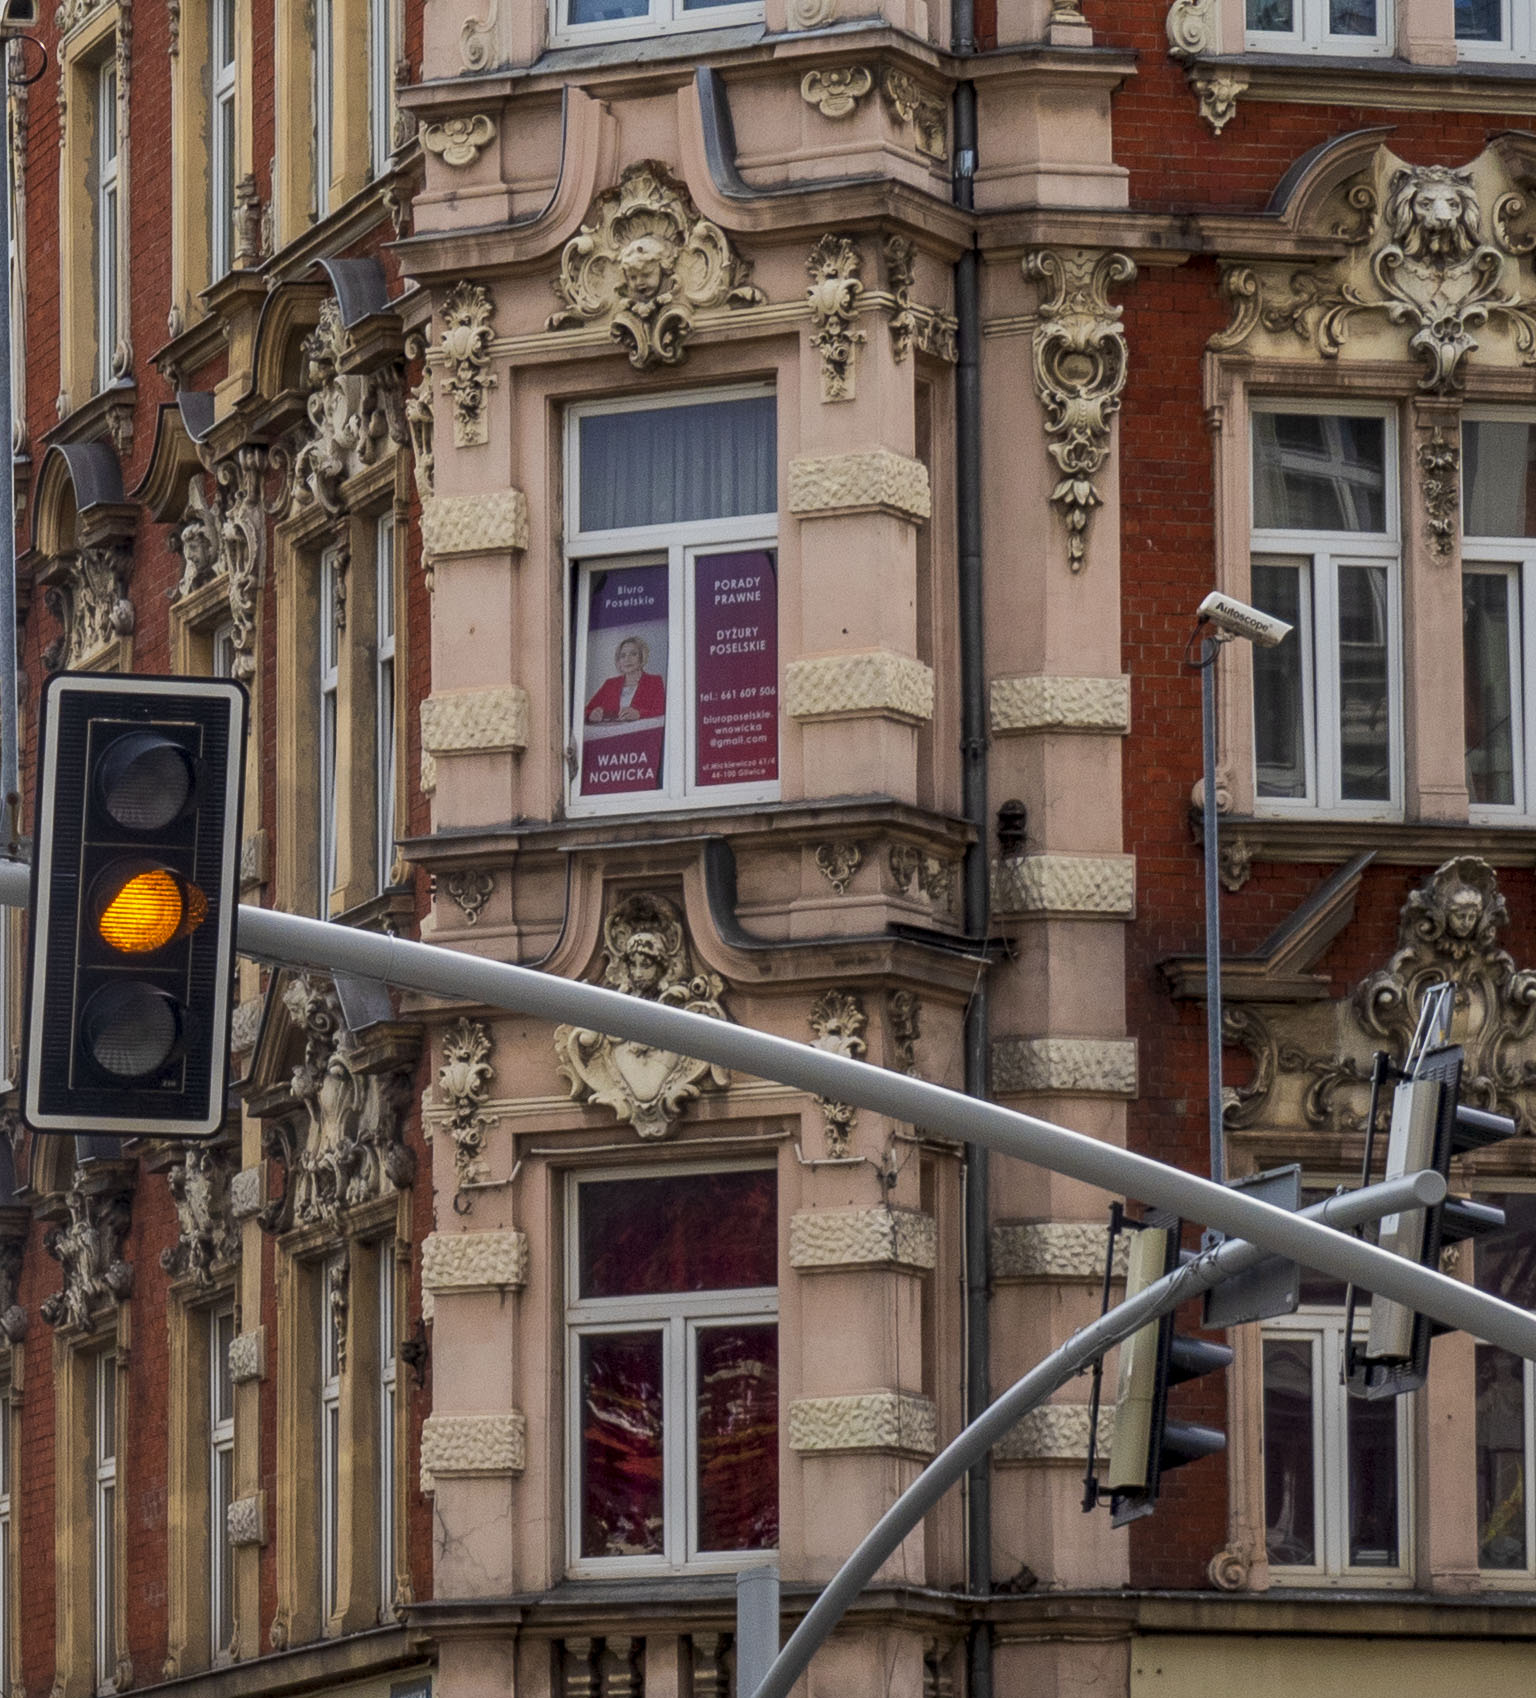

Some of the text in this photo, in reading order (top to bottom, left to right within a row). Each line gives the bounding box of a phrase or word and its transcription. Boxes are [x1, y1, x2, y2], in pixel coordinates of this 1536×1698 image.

[617, 585, 644, 595] Biuro
[714, 576, 761, 591] PORADY
[605, 595, 655, 609] Poselskie
[714, 590, 761, 606] PRAWNE
[716, 625, 759, 641] DYŻURY
[710, 640, 767, 656] POSELSKIE
[720, 689, 737, 700] 661
[739, 687, 757, 698] 609
[759, 686, 776, 696] 506
[597, 751, 648, 767] WANDA
[589, 767, 655, 783] NOWICKA
